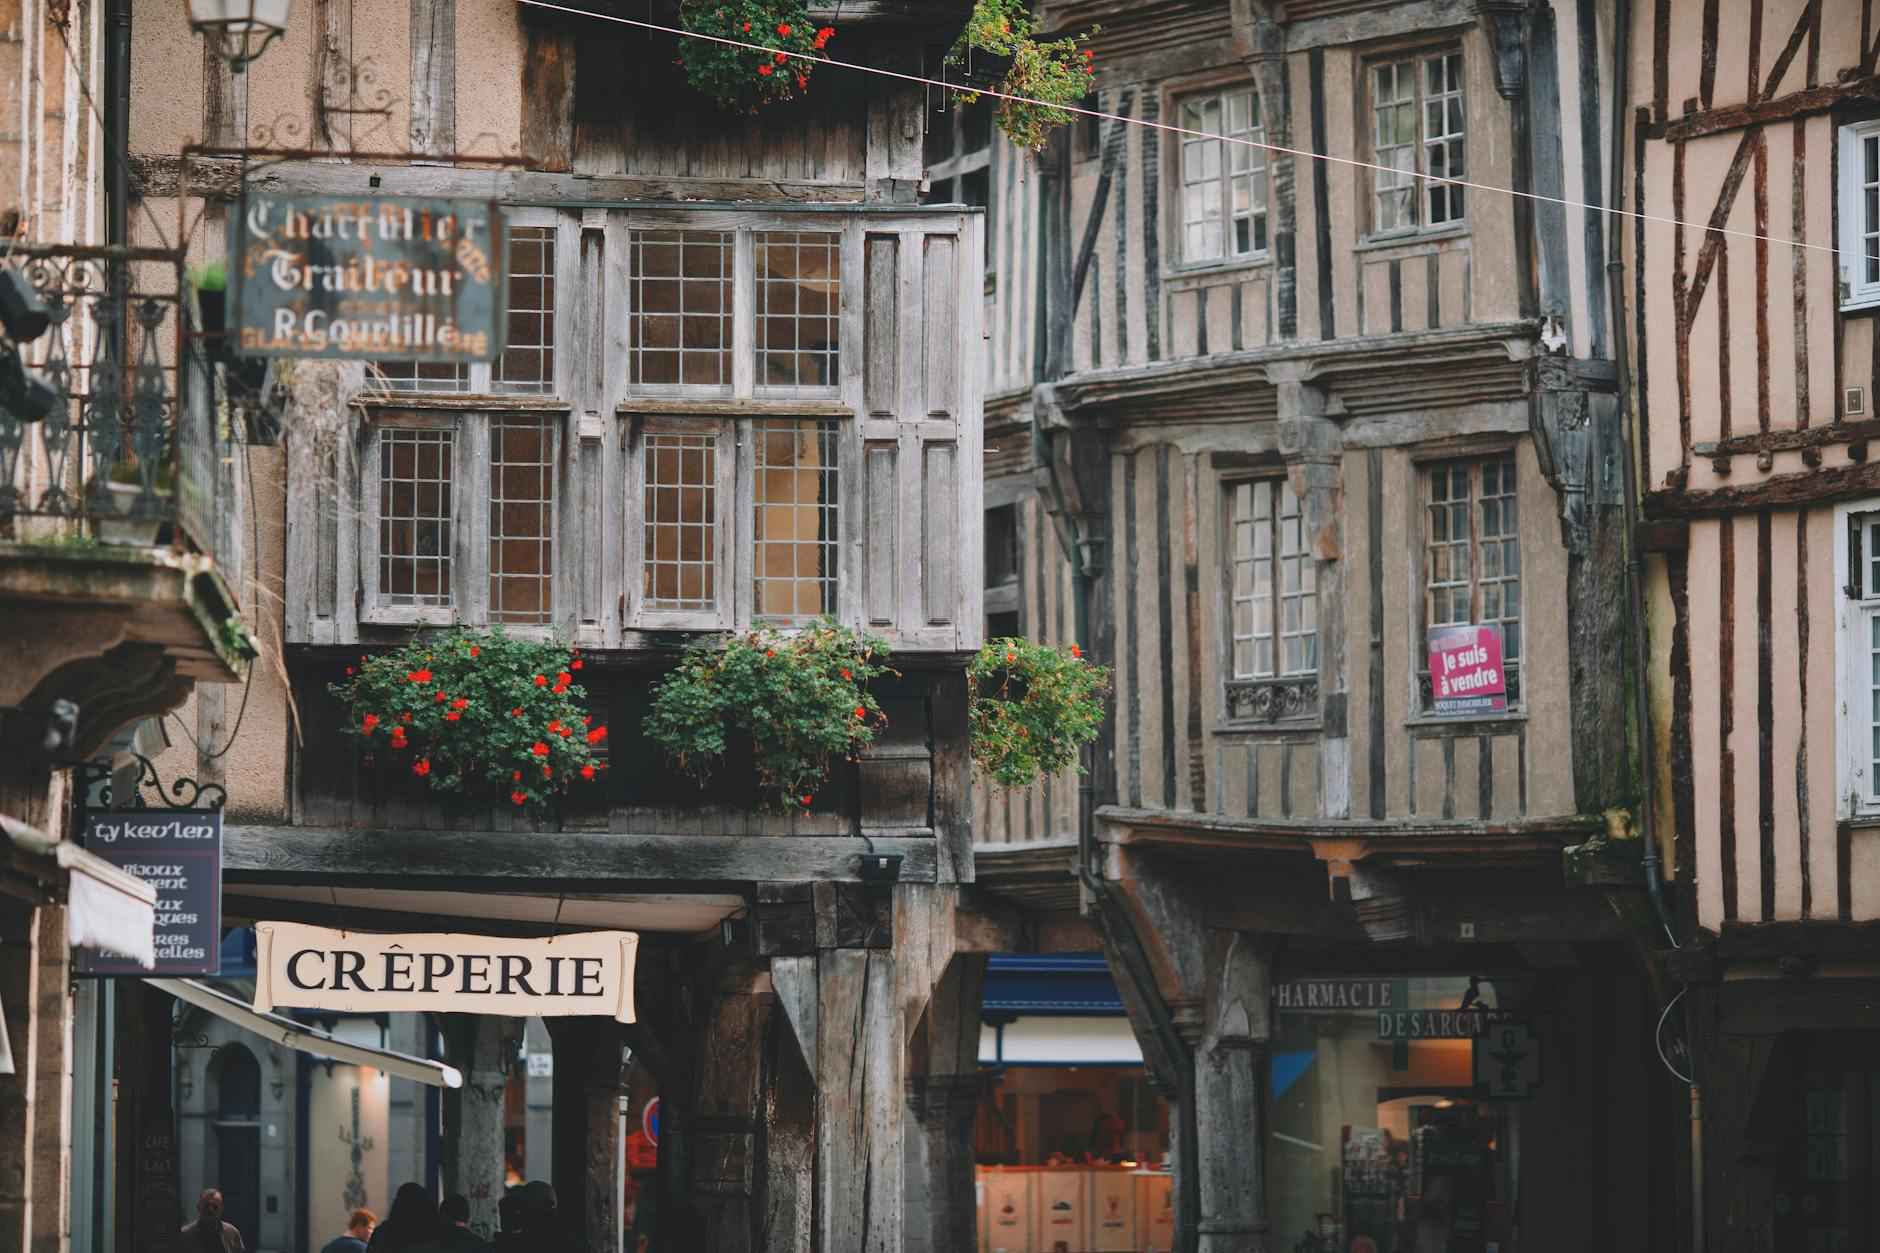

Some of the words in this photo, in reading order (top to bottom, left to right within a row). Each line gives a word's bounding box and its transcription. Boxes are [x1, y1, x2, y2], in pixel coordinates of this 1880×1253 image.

[1458, 644, 1488, 668] suis
[1440, 676, 1450, 695] à
[1450, 668, 1498, 692] vendre
[287, 944, 605, 997] CRÊPERIE
[1271, 982, 1392, 1007] HARMACIE
